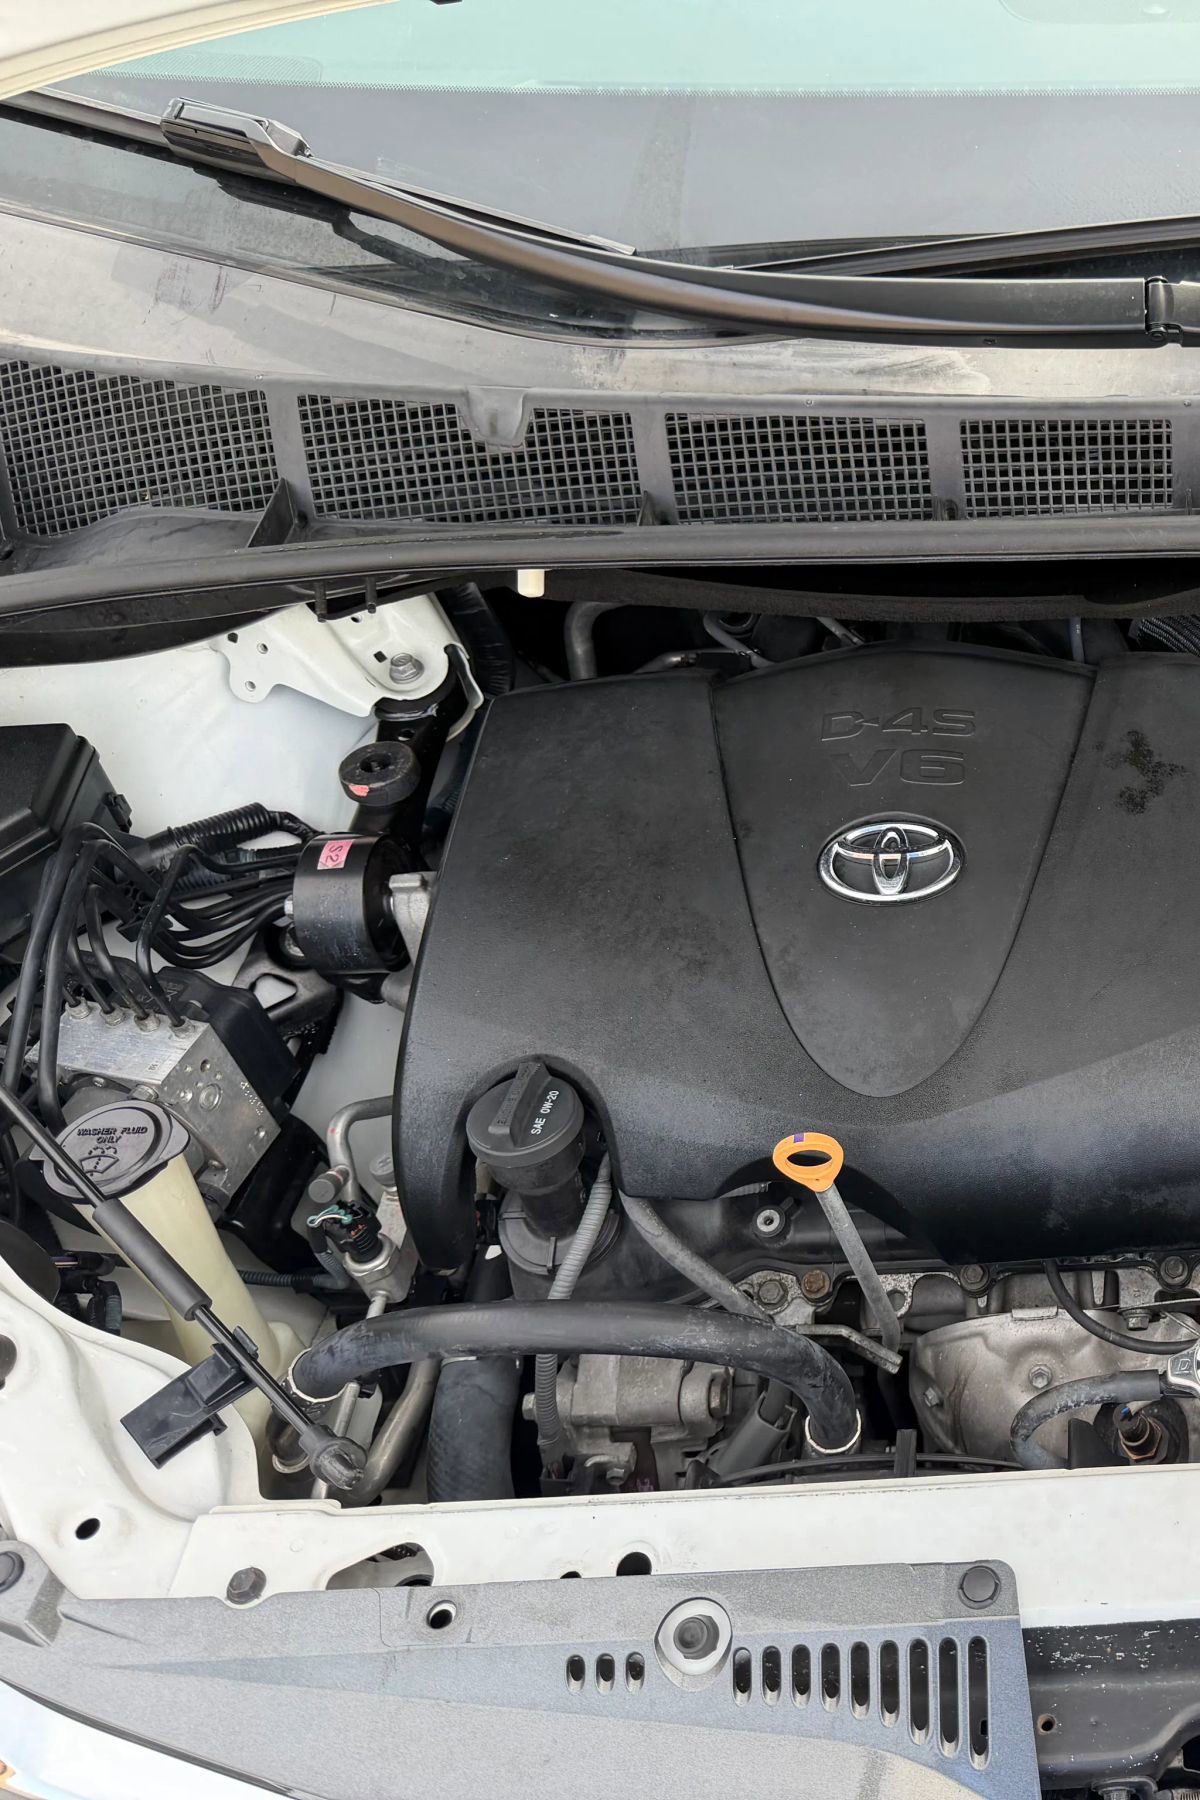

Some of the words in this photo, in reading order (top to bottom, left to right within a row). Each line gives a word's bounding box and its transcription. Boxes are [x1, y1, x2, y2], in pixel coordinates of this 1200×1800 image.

[821, 706, 976, 742] D-4S
[828, 748, 966, 787] V6
[530, 1117, 546, 1135] SAE
[540, 1090, 560, 1114] 0W-20
[76, 1127, 118, 1137] WASHER
[120, 1126, 148, 1136] FLUID
[96, 1135, 122, 1144] ONLY
